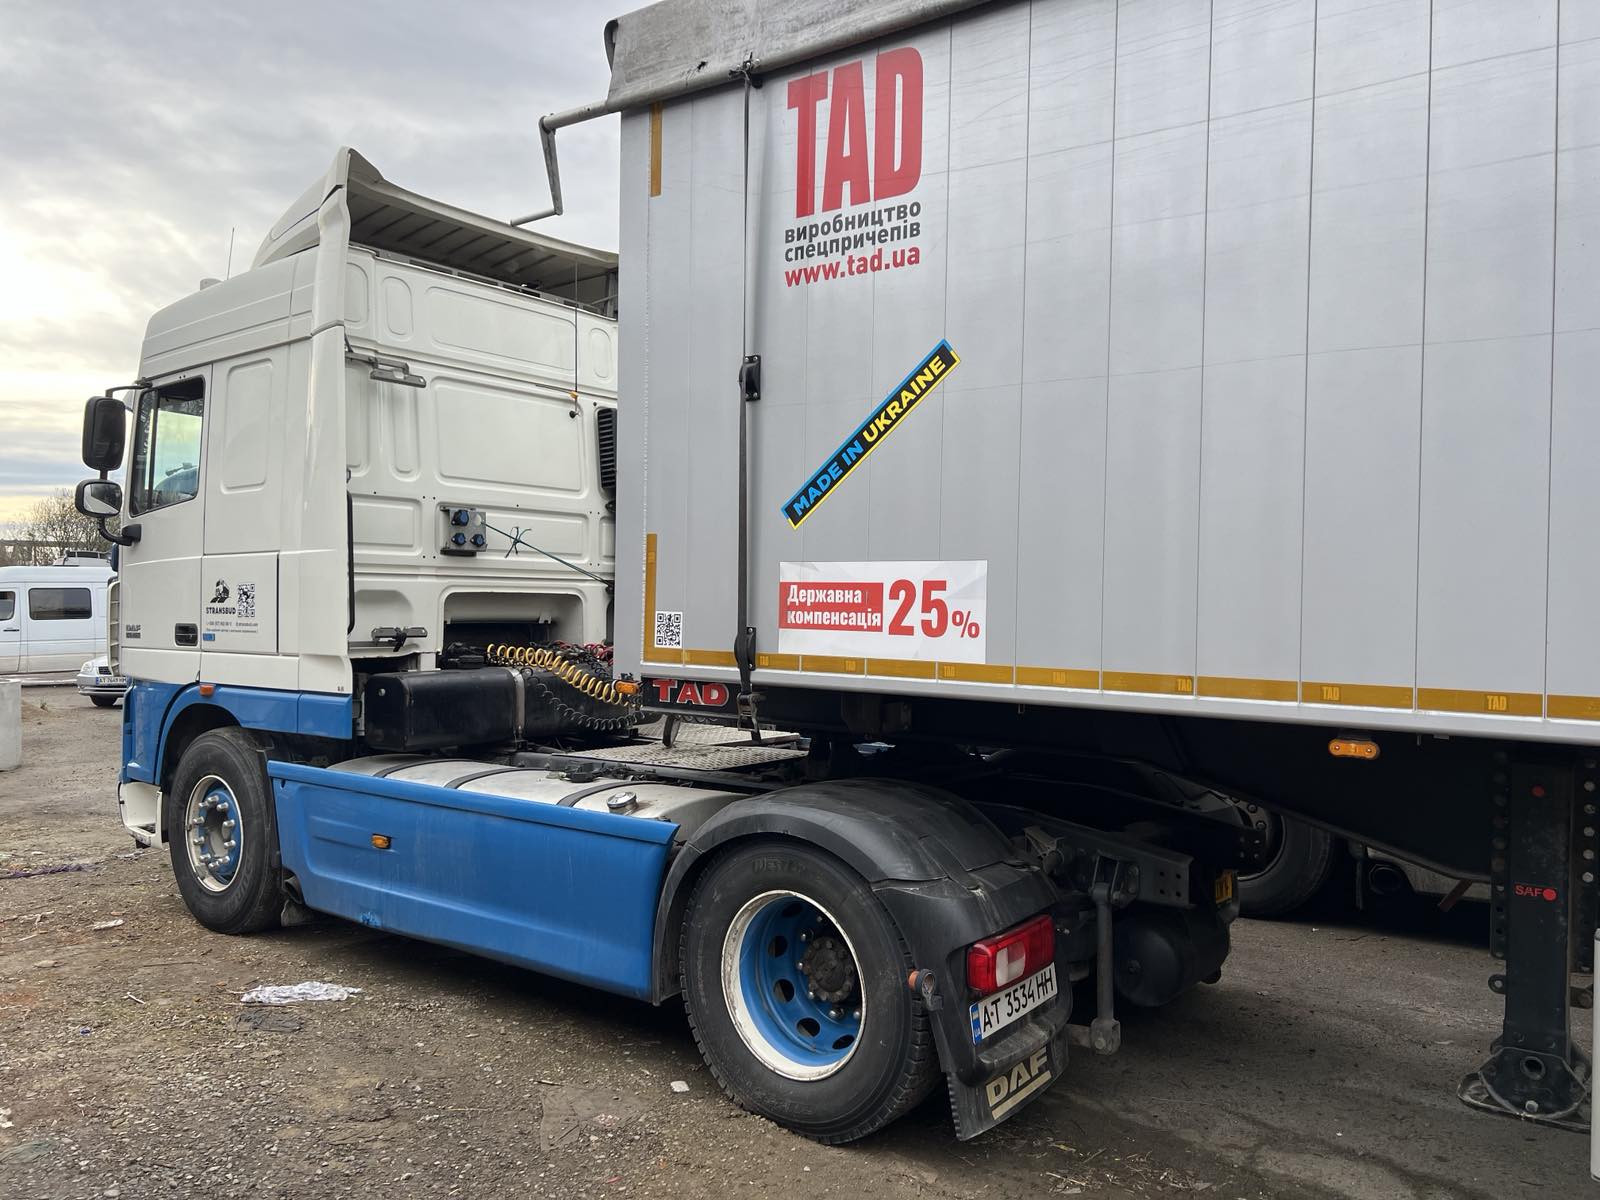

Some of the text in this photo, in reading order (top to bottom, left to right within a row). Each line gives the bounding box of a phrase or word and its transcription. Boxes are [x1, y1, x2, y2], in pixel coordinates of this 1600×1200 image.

[787, 47, 923, 218] TAD
[785, 201, 921, 243] виробництво
[785, 220, 920, 262] спецпричепів
[785, 247, 920, 287] www.tad.ua
[793, 356, 946, 516] MADE IN UKRAINE
[787, 584, 862, 606] Державна
[888, 579, 980, 638] 25%
[787, 608, 881, 629] компенсація
[653, 679, 729, 706] TAD
[1177, 678, 1192, 692] TAD
[1323, 687, 1340, 701] TAD
[1487, 695, 1507, 711] TAD
[1515, 885, 1542, 897] SAF
[983, 968, 1054, 1033] AT 3534 HH
[986, 1046, 1048, 1107] DAF
